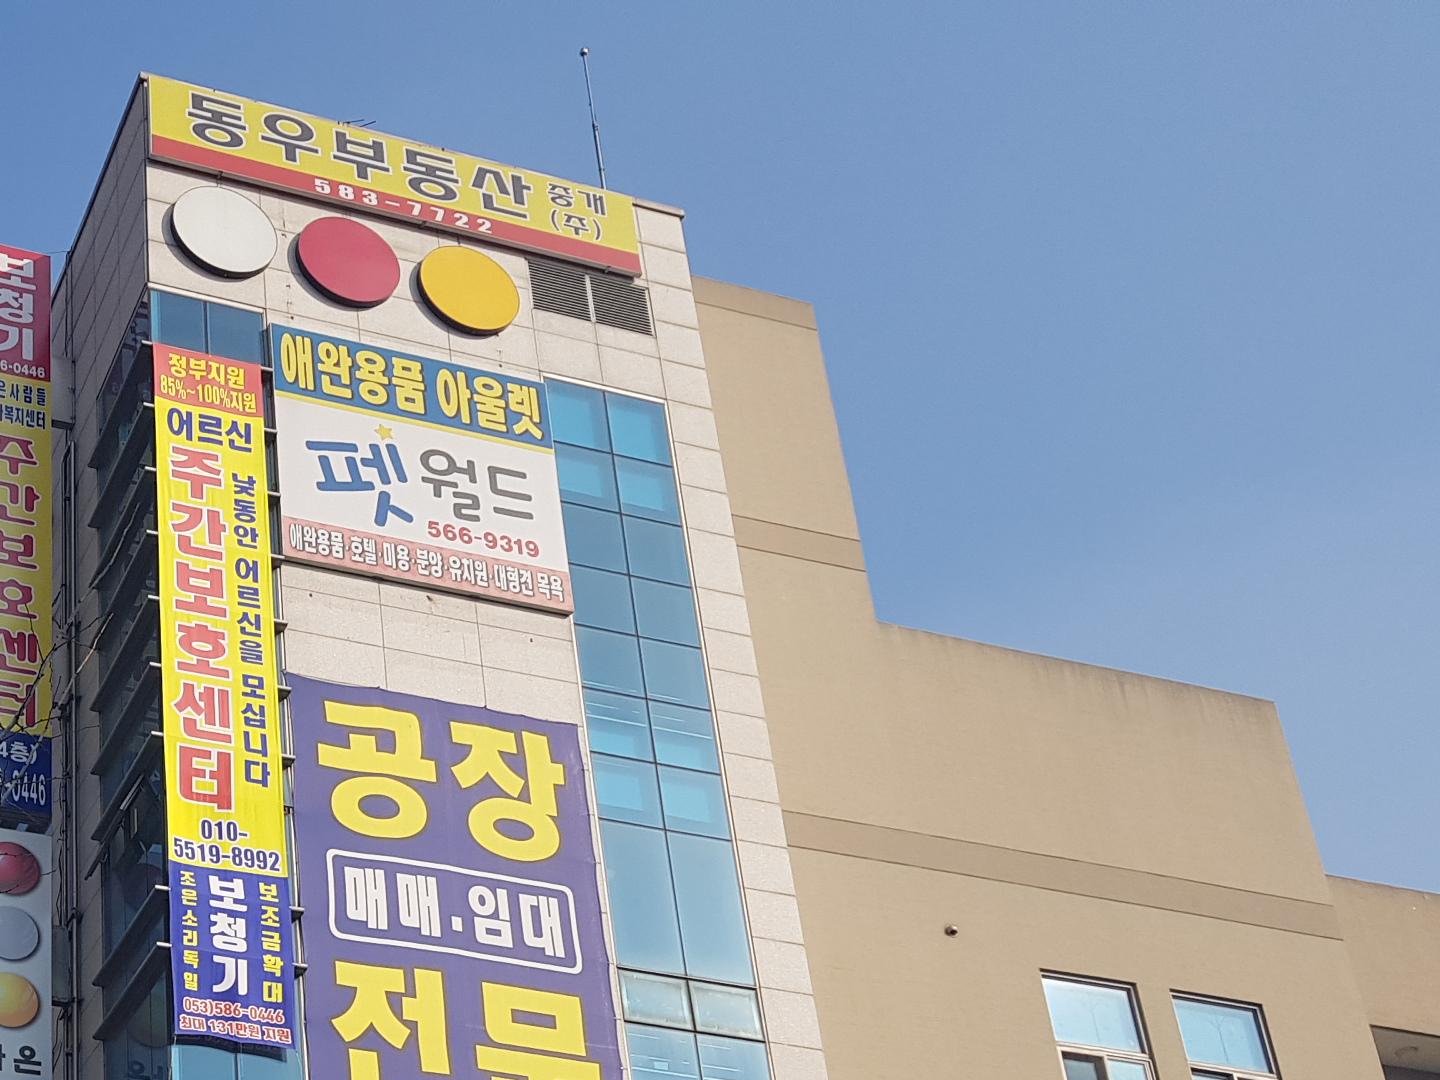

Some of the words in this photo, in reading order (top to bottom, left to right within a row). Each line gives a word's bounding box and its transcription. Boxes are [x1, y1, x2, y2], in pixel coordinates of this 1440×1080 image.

[186, 90, 533, 220] 동우부동산
[314, 177, 493, 235] 583-7722
[546, 181, 607, 217] 중개
[550, 208, 603, 241] (주)
[168, 352, 246, 390] 정부지원
[280, 332, 427, 415] 애완용품
[436, 368, 544, 440] 아울렛
[167, 407, 252, 453] 어르신
[305, 439, 535, 528] 펫월드
[427, 519, 540, 559] 566-9319
[537, 571, 564, 602] 목욕
[169, 445, 234, 812] 주간보호센터
[241, 673, 271, 788] 모십니다
[317, 700, 566, 863] 공장
[201, 819, 249, 843] 010-
[173, 836, 281, 872] 5519-8992
[208, 875, 248, 996] 보청기
[180, 1014, 206, 1032] 최대
[209, 1017, 261, 1039] 131만원
[261, 1026, 292, 1044] 지원
[183, 997, 285, 1024] 053)586-0446
